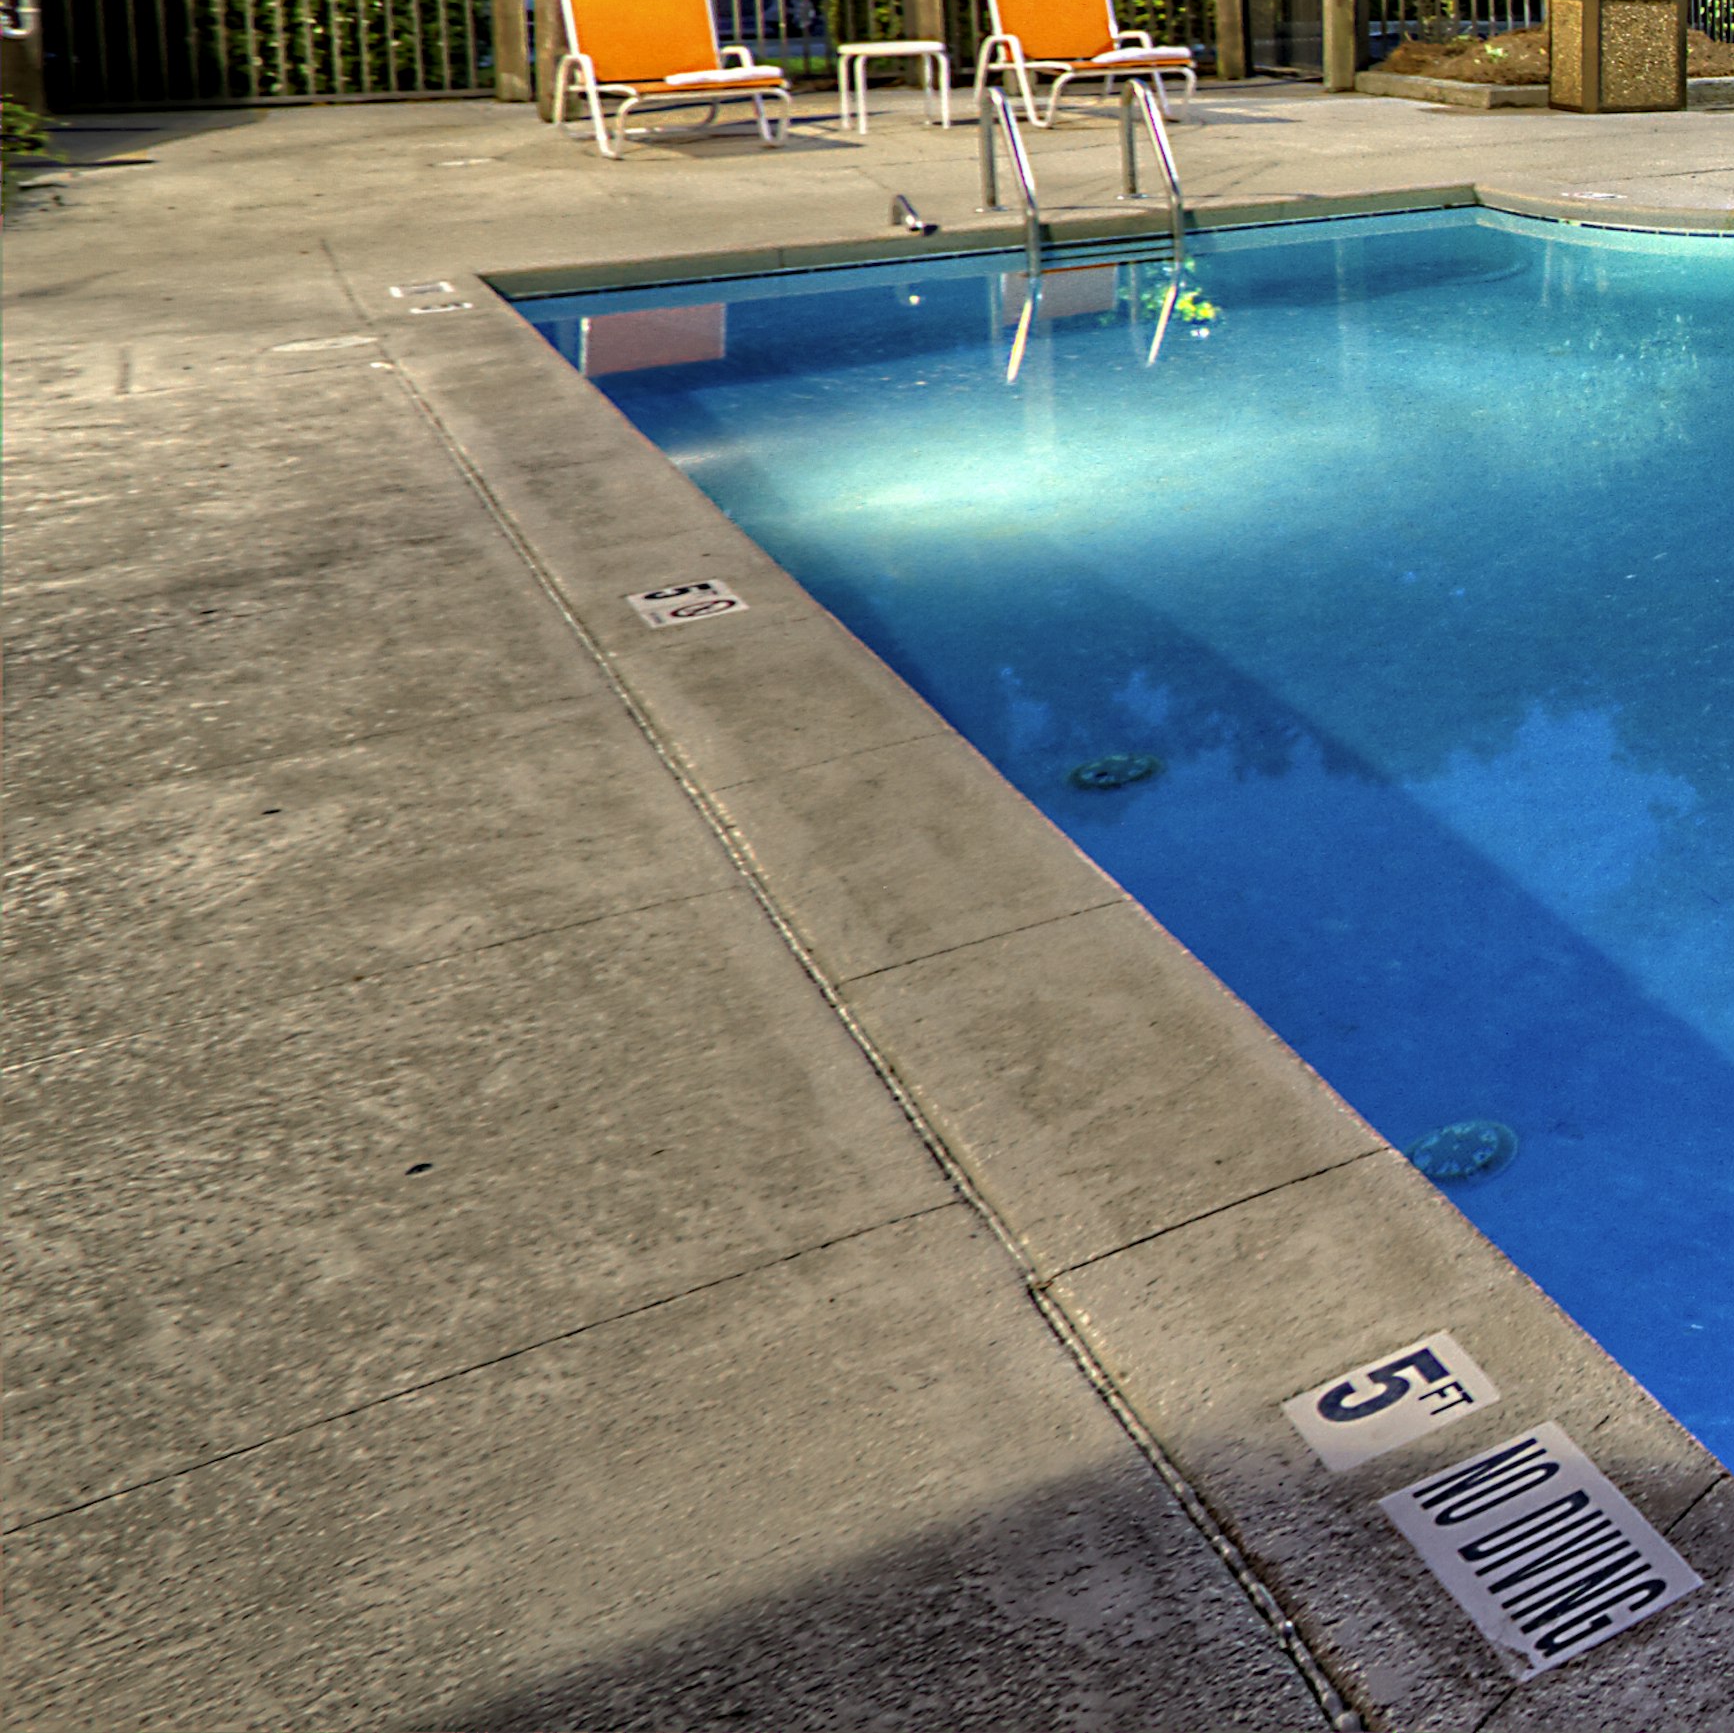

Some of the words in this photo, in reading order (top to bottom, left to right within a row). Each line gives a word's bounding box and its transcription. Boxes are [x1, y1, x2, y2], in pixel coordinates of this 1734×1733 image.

[644, 583, 711, 600] 5
[1316, 1347, 1451, 1423] 5
[1418, 1380, 1474, 1416] FT
[1412, 1437, 1561, 1526] NO
[1457, 1490, 1668, 1658] DIVING
